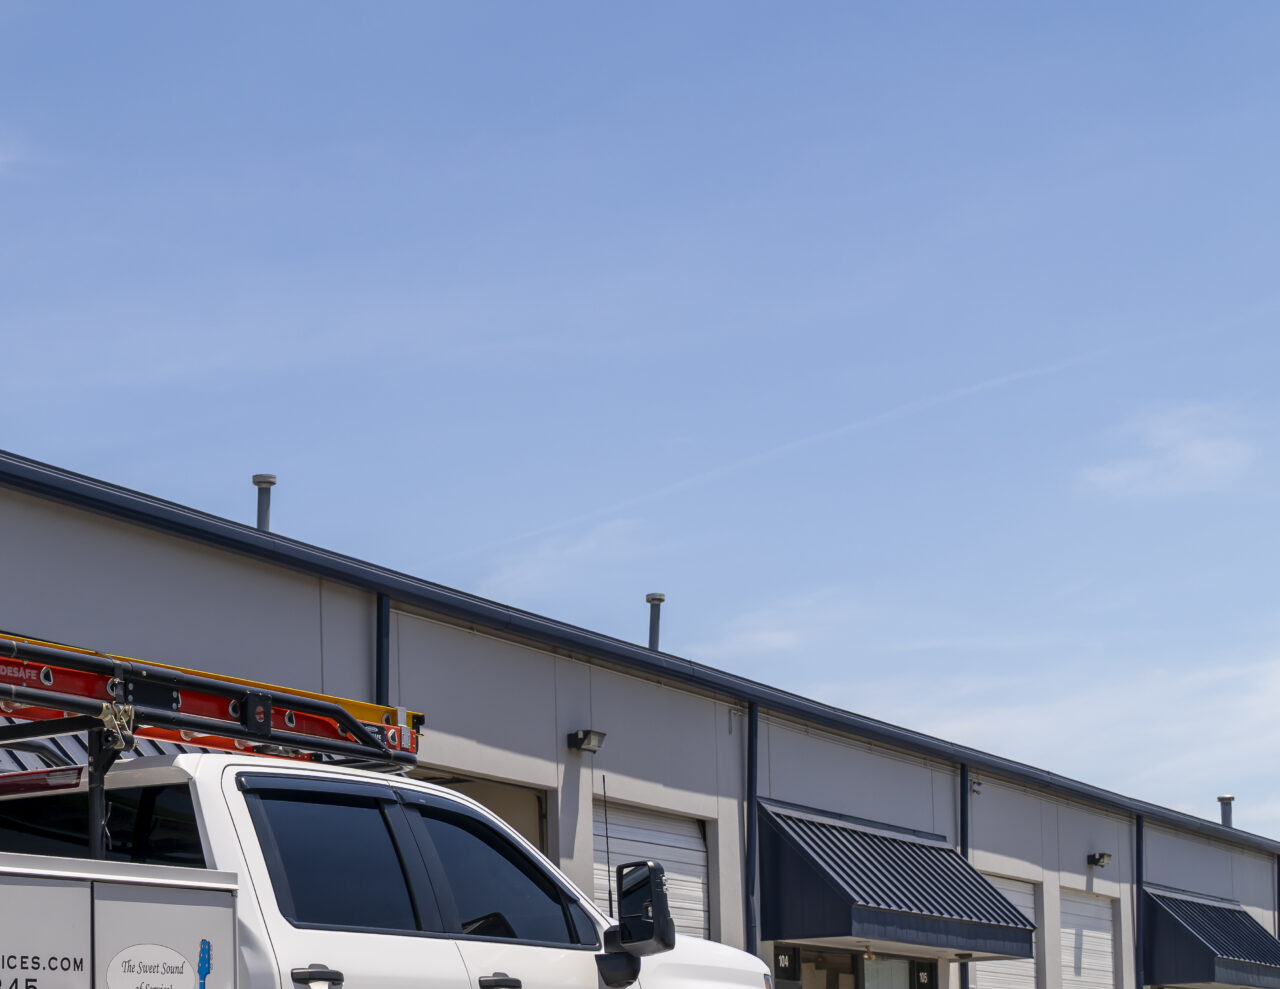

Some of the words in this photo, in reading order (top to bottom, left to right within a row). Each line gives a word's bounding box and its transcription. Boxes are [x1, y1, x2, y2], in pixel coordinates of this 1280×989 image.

[121, 959, 136, 974] The
[136, 961, 160, 975] Sweet
[161, 960, 186, 976] Sound
[778, 954, 789, 968] 104
